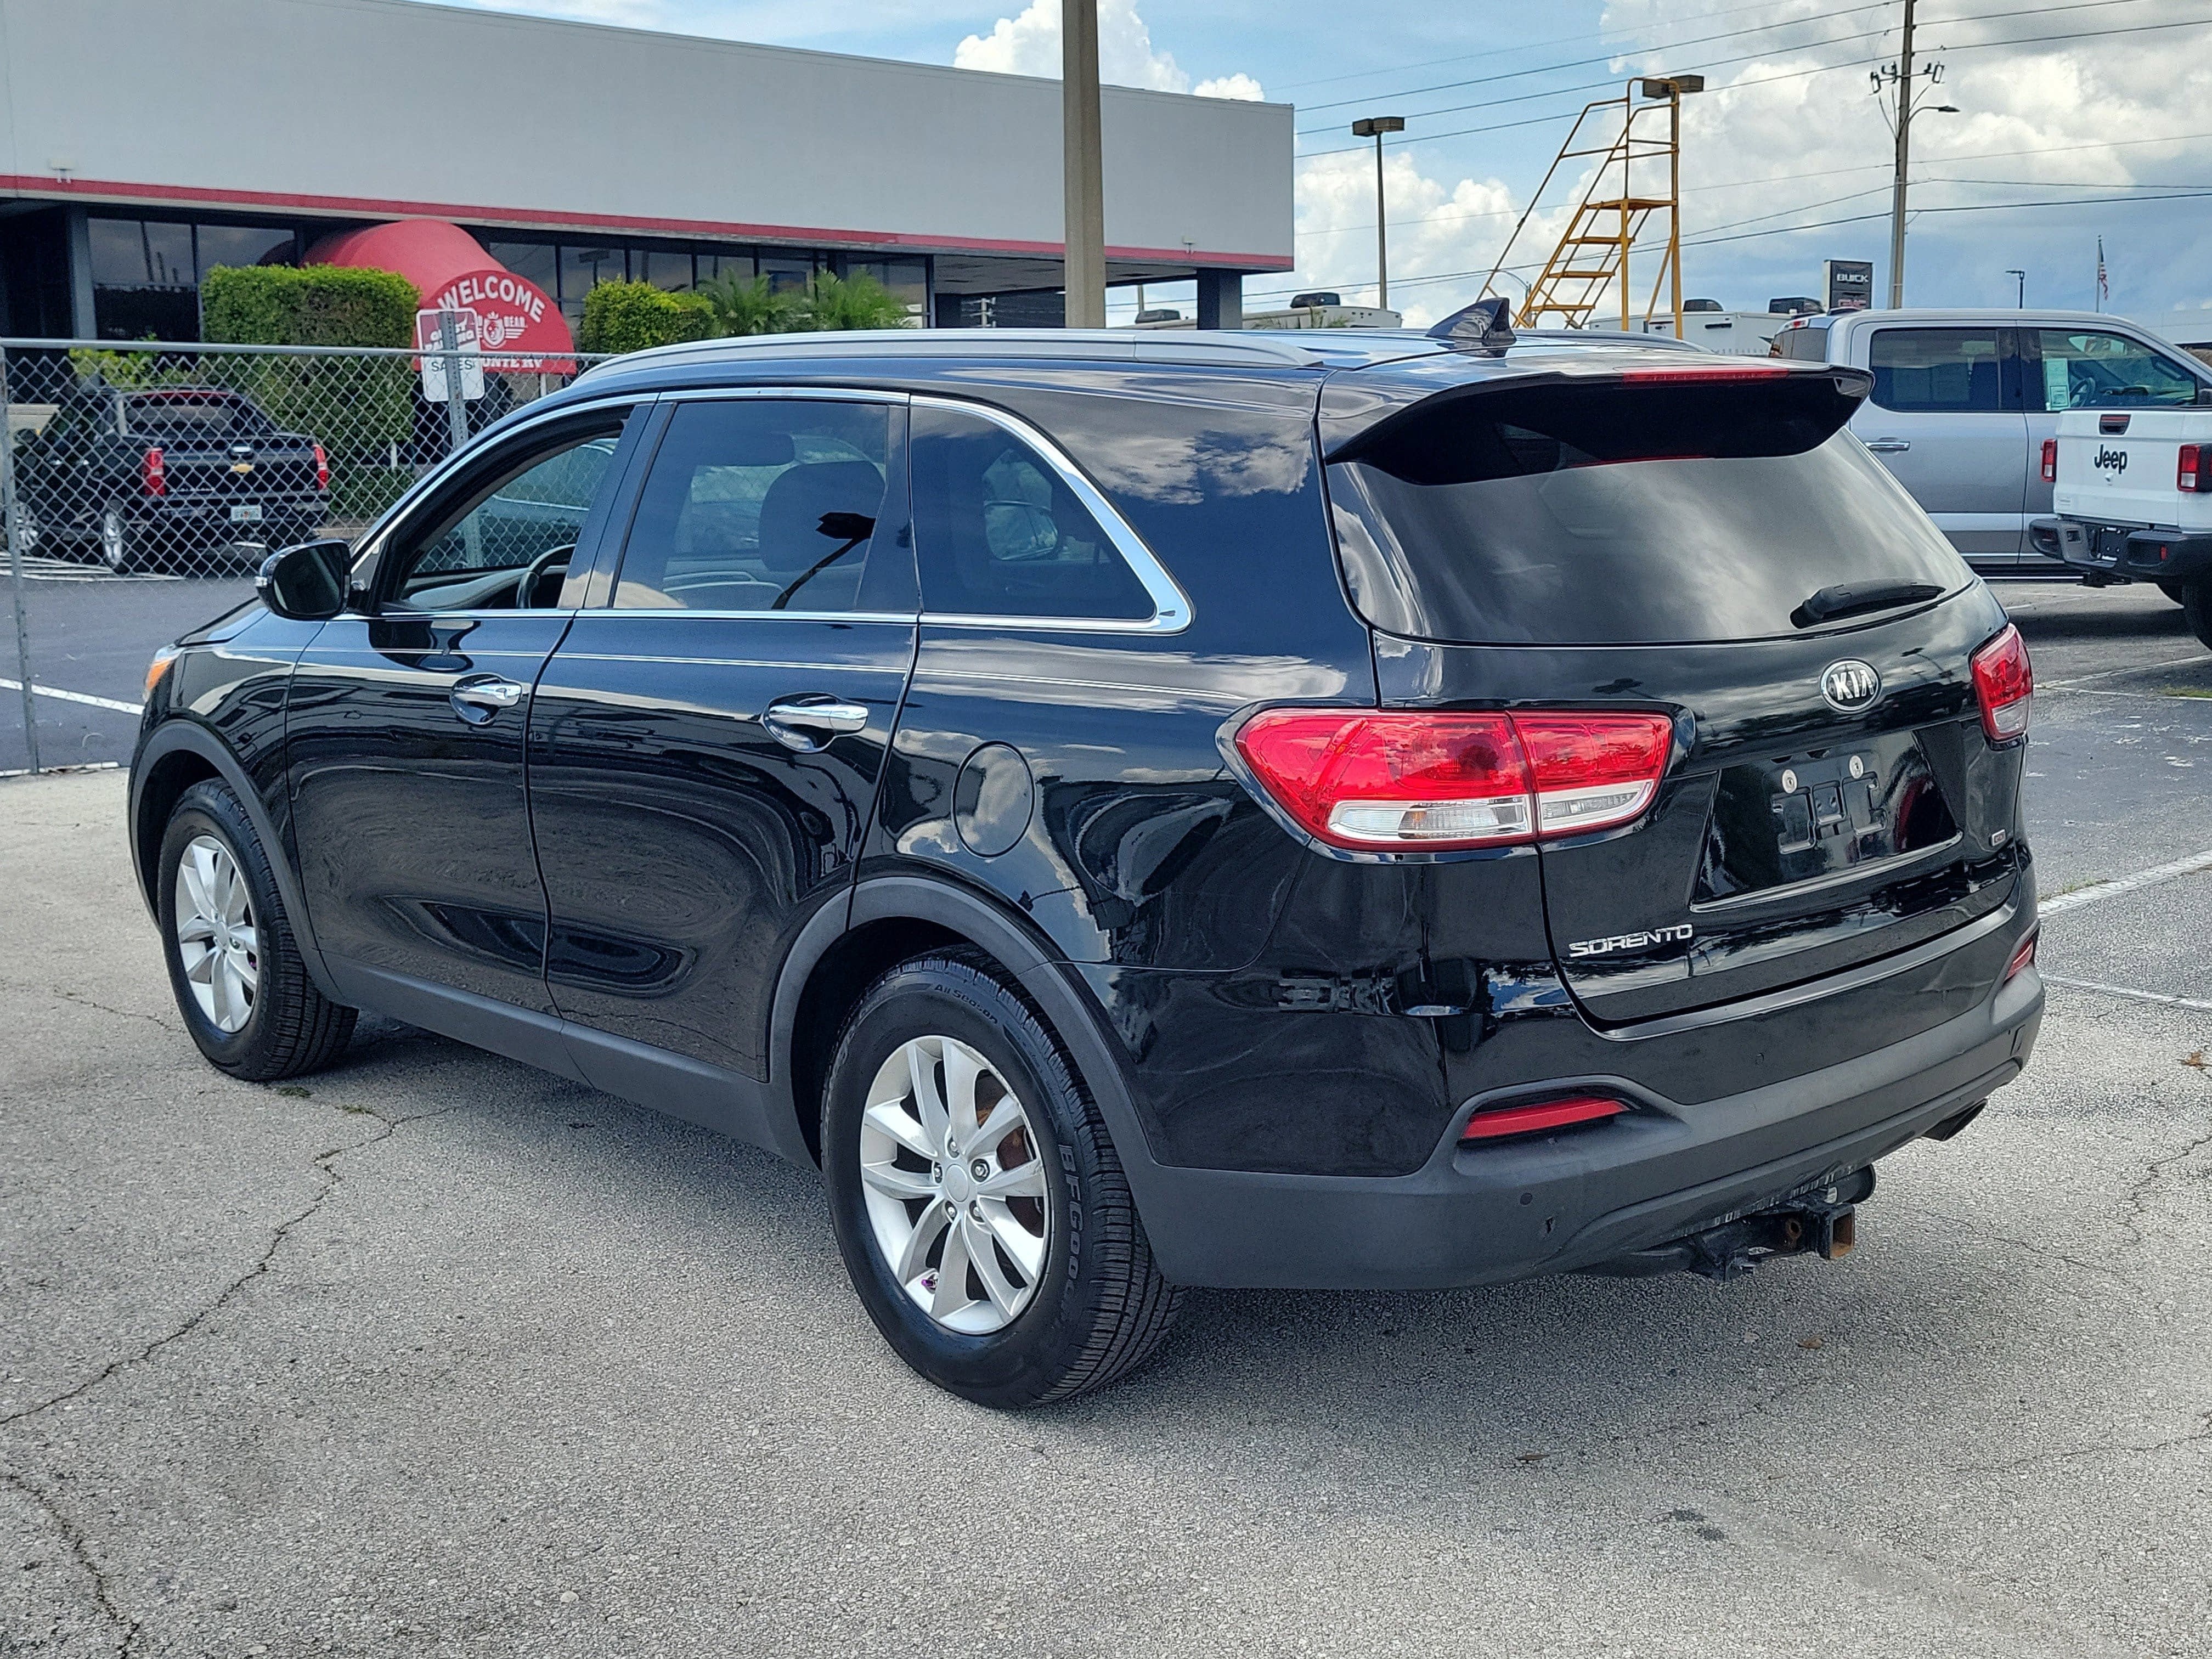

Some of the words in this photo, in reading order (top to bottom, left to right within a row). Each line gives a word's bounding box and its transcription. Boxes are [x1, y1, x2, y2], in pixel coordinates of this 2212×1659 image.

[1837, 273, 1869, 283] BUICK
[437, 275, 545, 323] WELCOME
[431, 359, 472, 372] SAES
[2094, 444, 2128, 475] Jeep
[1831, 669, 1874, 701] KIA
[1568, 924, 1693, 957] SORENTO
[934, 983, 950, 995] All
